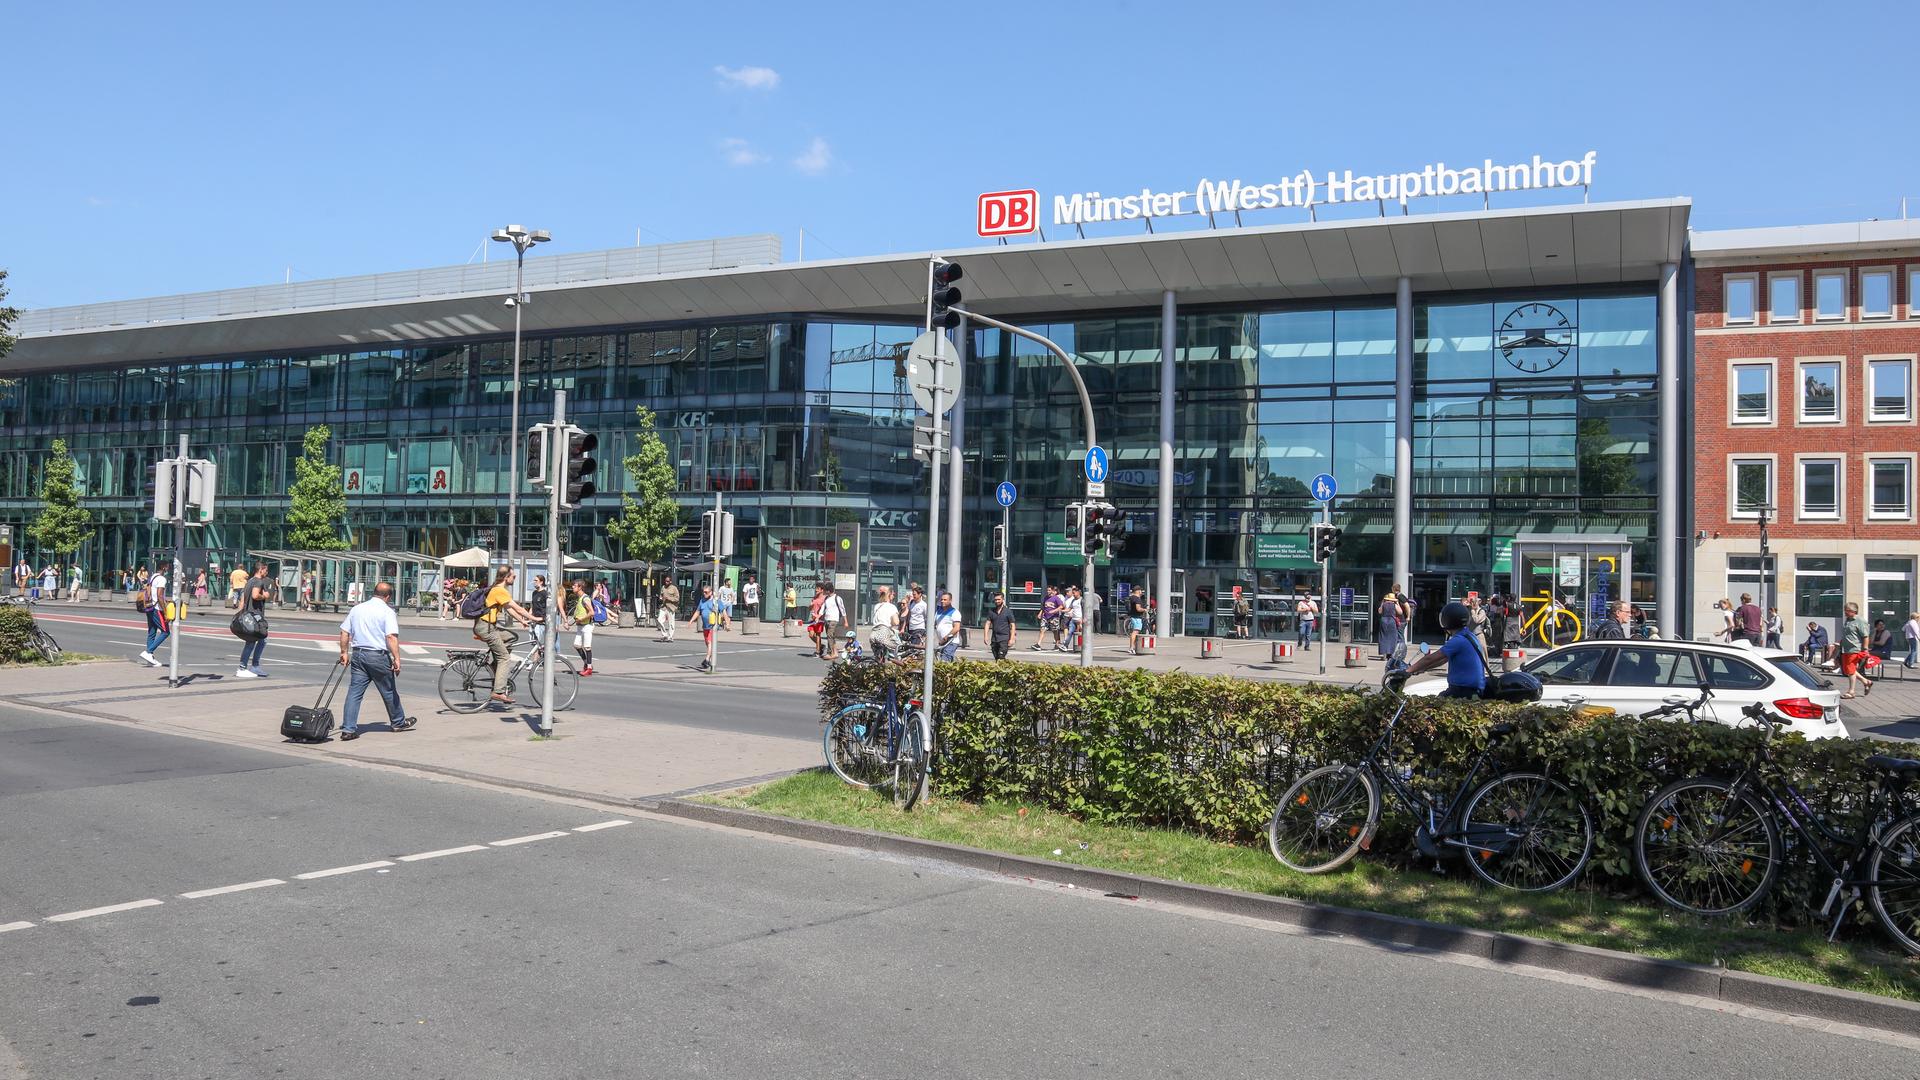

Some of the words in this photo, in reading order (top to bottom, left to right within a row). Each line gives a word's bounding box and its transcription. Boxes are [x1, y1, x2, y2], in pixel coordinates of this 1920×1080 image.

[1054, 188, 1187, 224] Münster
[1196, 169, 1315, 216] (Westf)
[1327, 151, 1597, 205] Hauptbahnhof
[985, 197, 1029, 229] DB
[672, 411, 714, 428] KFC
[870, 510, 919, 528] KFC
